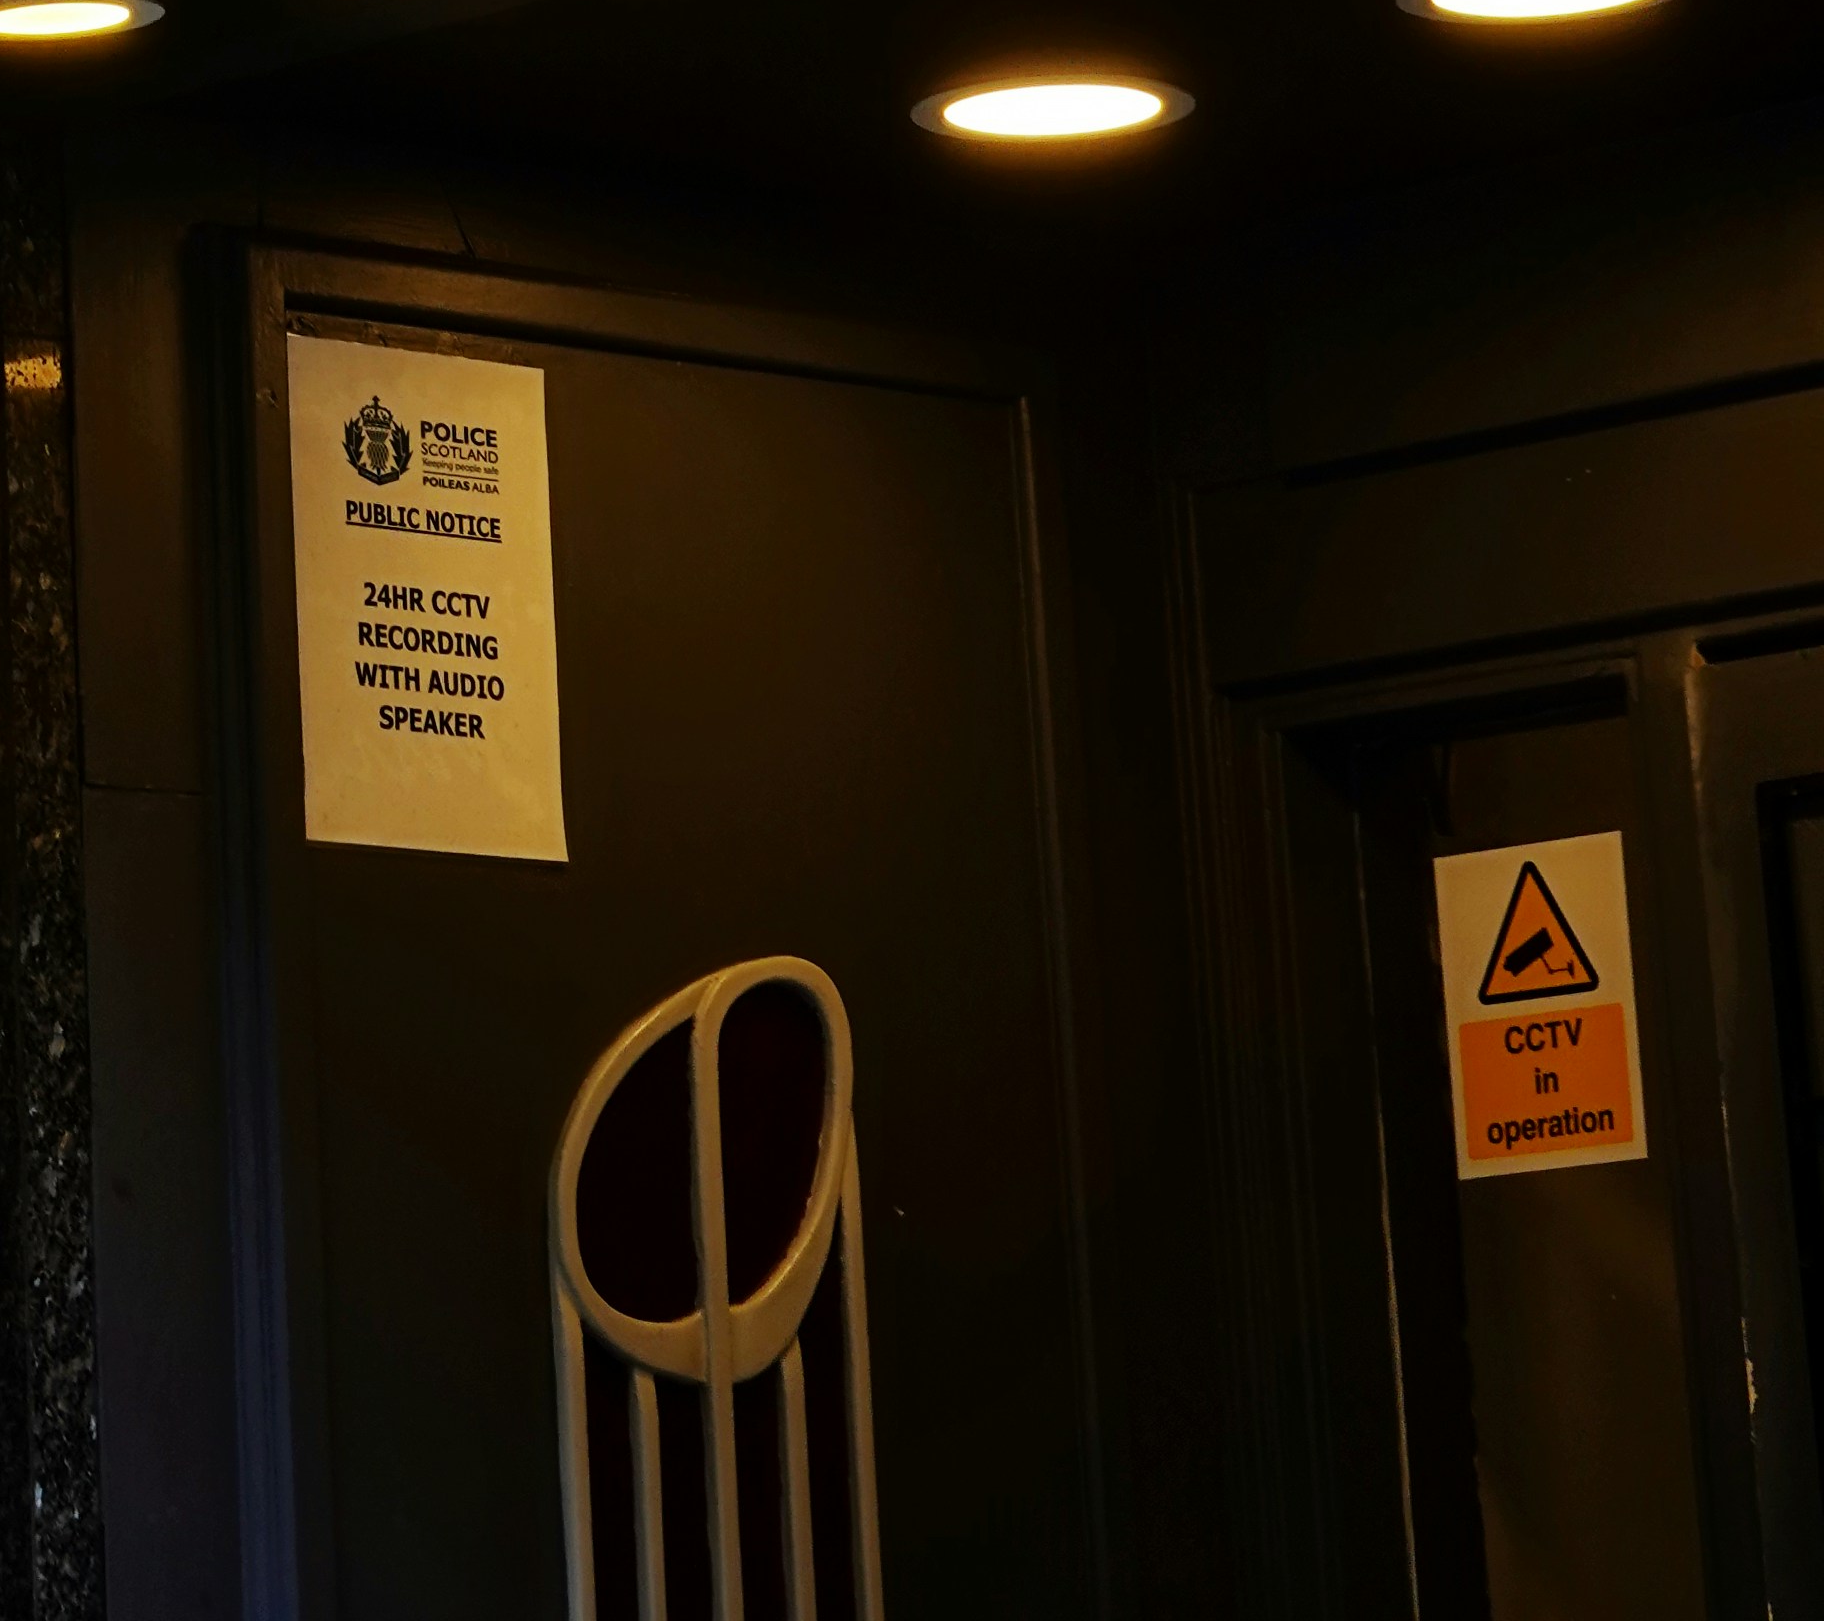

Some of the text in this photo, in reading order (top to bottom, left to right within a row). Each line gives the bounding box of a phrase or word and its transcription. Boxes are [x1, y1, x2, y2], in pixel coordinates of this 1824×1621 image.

[420, 420, 498, 448] POLICE
[421, 442, 499, 464] SCOTLAND
[422, 458, 453, 472] Keeping
[455, 463, 482, 475] people
[422, 476, 500, 495] POILEAS ALBA
[345, 499, 501, 539] PUBLIC NOTICE
[363, 581, 490, 620] 24HR CCTV
[358, 621, 499, 661] RECORDING
[355, 661, 505, 702] WITH AUDIO
[378, 705, 486, 740] SPEAKER
[1504, 1018, 1583, 1055] CCTV
[1534, 1066, 1560, 1095] in
[1487, 1107, 1616, 1151] operation
